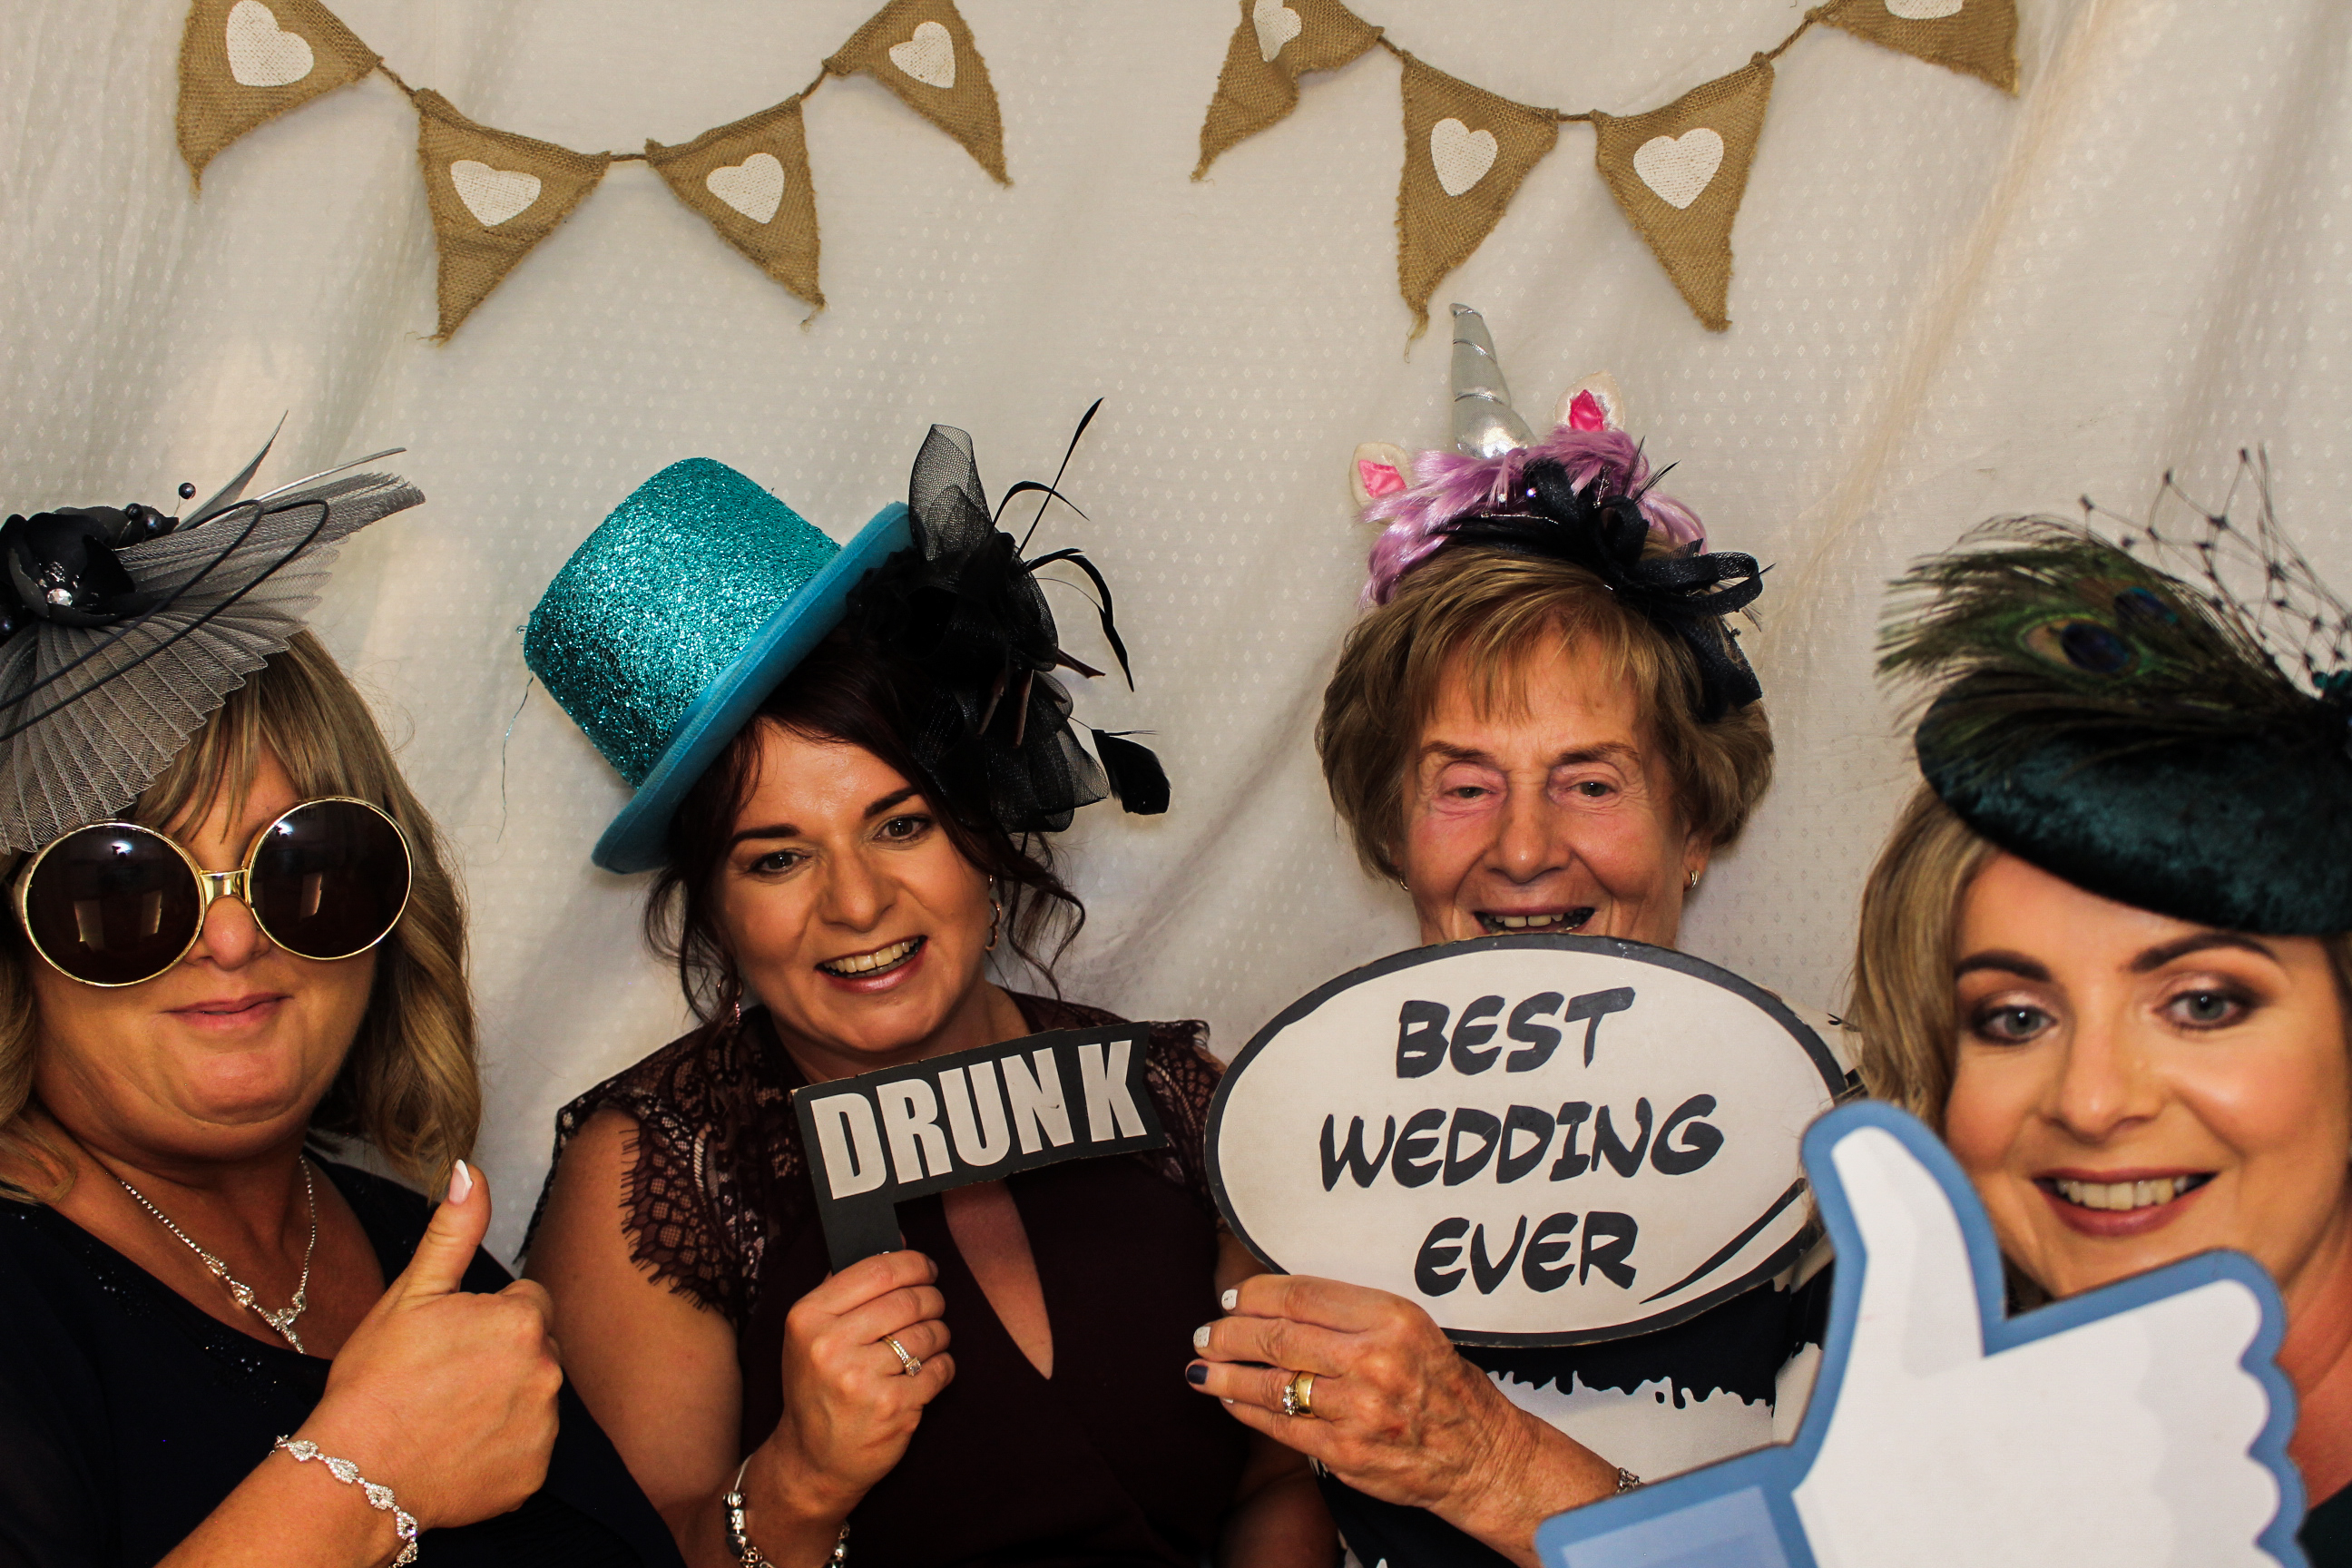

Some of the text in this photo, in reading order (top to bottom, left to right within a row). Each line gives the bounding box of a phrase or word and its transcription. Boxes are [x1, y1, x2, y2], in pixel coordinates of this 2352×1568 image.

[1396, 987, 1635, 1078] BEST
[810, 1040, 1147, 1200] DRUNK
[1319, 1094, 1724, 1191] WEDDING
[1415, 1211, 1638, 1297] EVER
